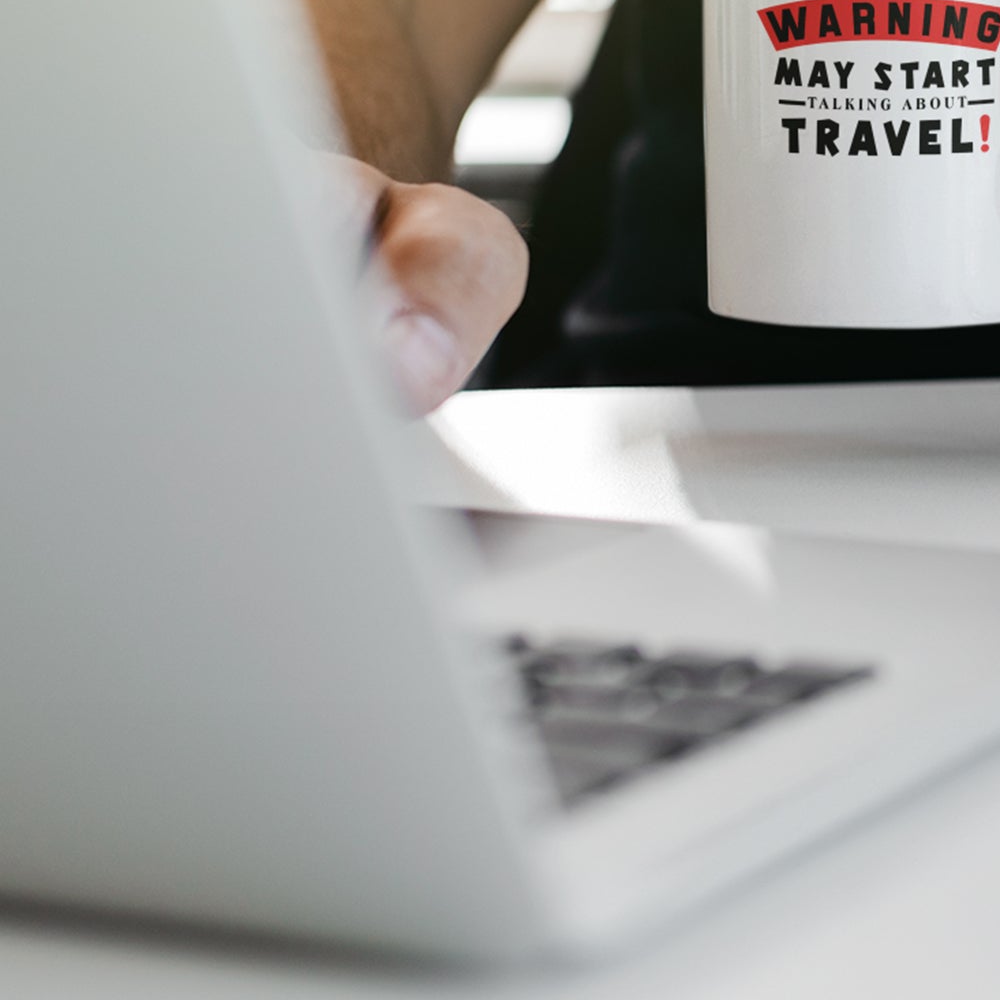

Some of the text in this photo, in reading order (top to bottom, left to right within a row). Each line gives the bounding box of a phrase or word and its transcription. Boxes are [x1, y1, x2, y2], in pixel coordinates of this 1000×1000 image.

[774, 57, 995, 91] MAY START
[807, 96, 967, 111] TALKING ABOUT
[781, 114, 991, 157] TRAVEL!
